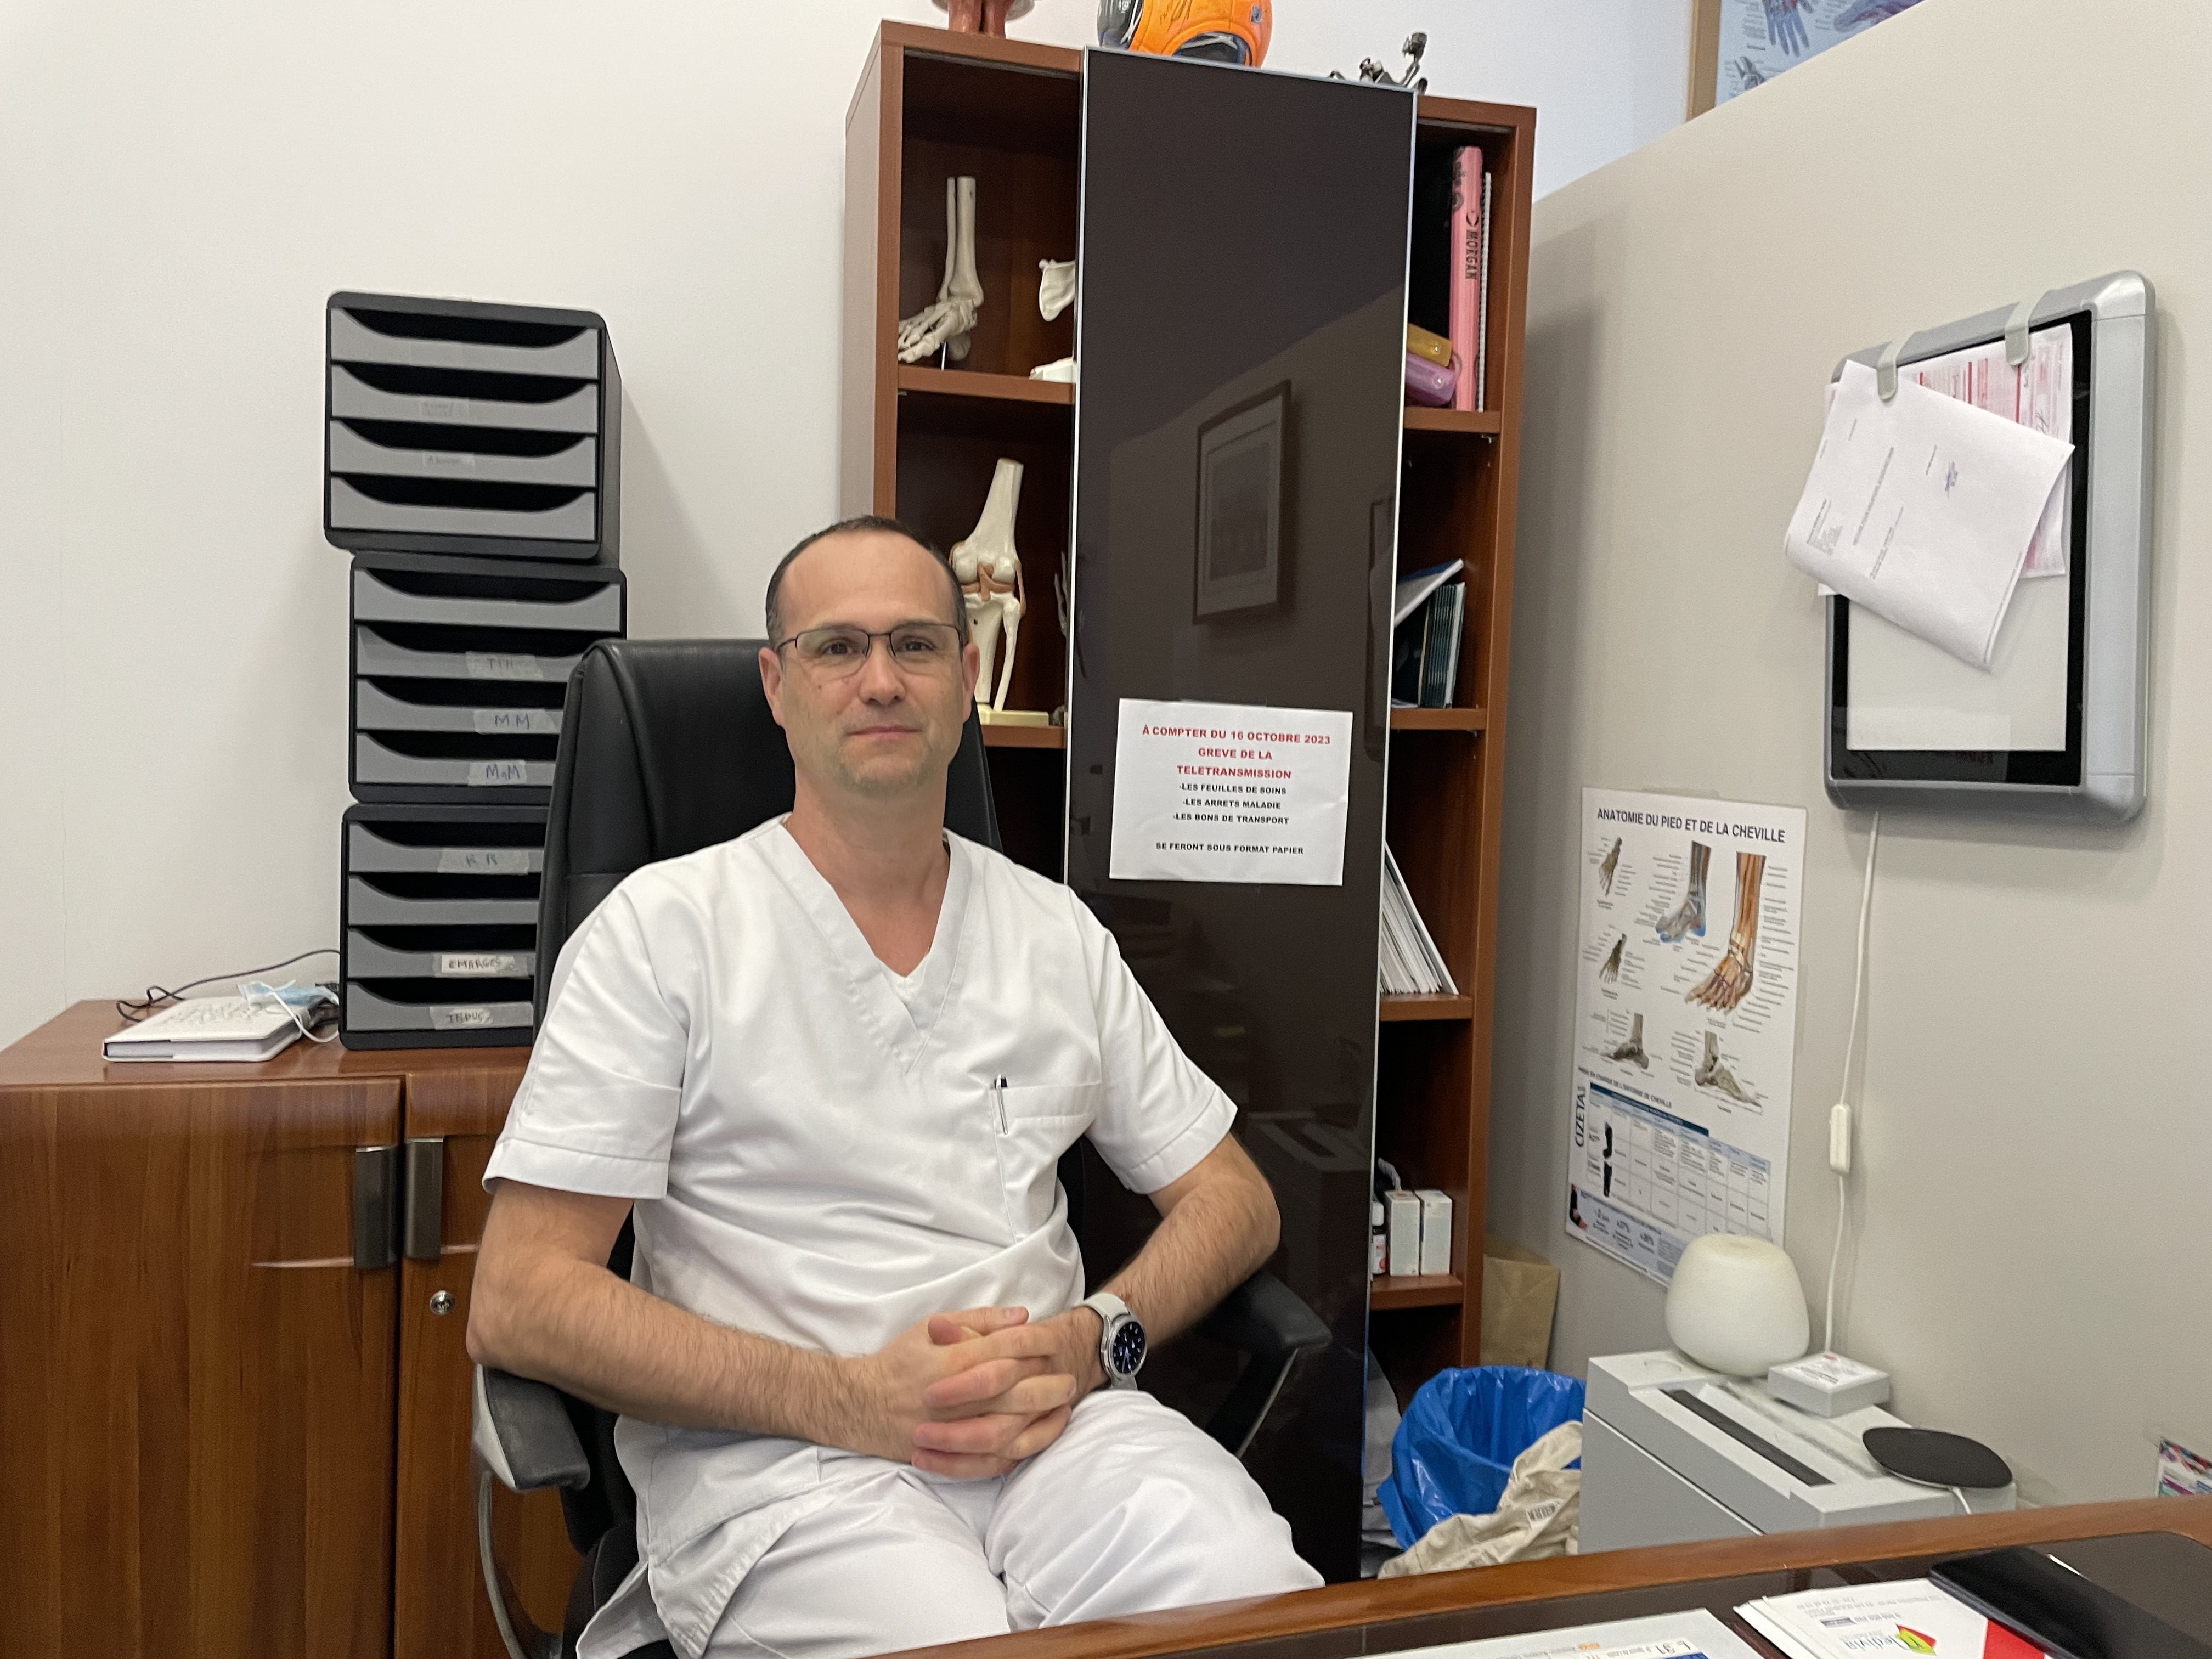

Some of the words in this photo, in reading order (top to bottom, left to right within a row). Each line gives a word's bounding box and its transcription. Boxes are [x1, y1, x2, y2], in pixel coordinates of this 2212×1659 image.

[1465, 230, 1479, 280] MORGAN
[1153, 726, 1207, 738] COMPTER
[1211, 729, 1227, 739] DU
[1231, 730, 1244, 741] 16
[1247, 731, 1301, 743] OCTOBRE
[1305, 734, 1330, 744] 2023
[1198, 747, 1237, 758] GREVE
[1240, 749, 1255, 759] DE
[1259, 751, 1272, 760] LA
[1177, 764, 1291, 779] TELETRANSMISSION
[1201, 783, 1243, 793] FEUILLES
[1246, 786, 1257, 794] DE
[1260, 786, 1286, 795] SOINS
[1204, 798, 1240, 808] ARRETS
[1243, 800, 1281, 810] MALADIE
[1194, 813, 1219, 822] BONS
[1222, 814, 1233, 823] DE
[1237, 815, 1289, 825] TRANSPORT
[1598, 807, 1644, 825] ANATOMIE
[1646, 813, 1658, 827] DU
[1661, 815, 1682, 830] PIED
[1685, 818, 1697, 831] ET
[1700, 820, 1714, 834] DE
[1716, 822, 1729, 836] LA
[1732, 824, 1786, 843] CHEVILLE
[1156, 842, 1167, 850] SE
[1170, 842, 1205, 851] FERONT
[1207, 843, 1231, 852] SOUS
[1234, 845, 1269, 854] FORMAT
[1272, 845, 1304, 855] PAPIER
